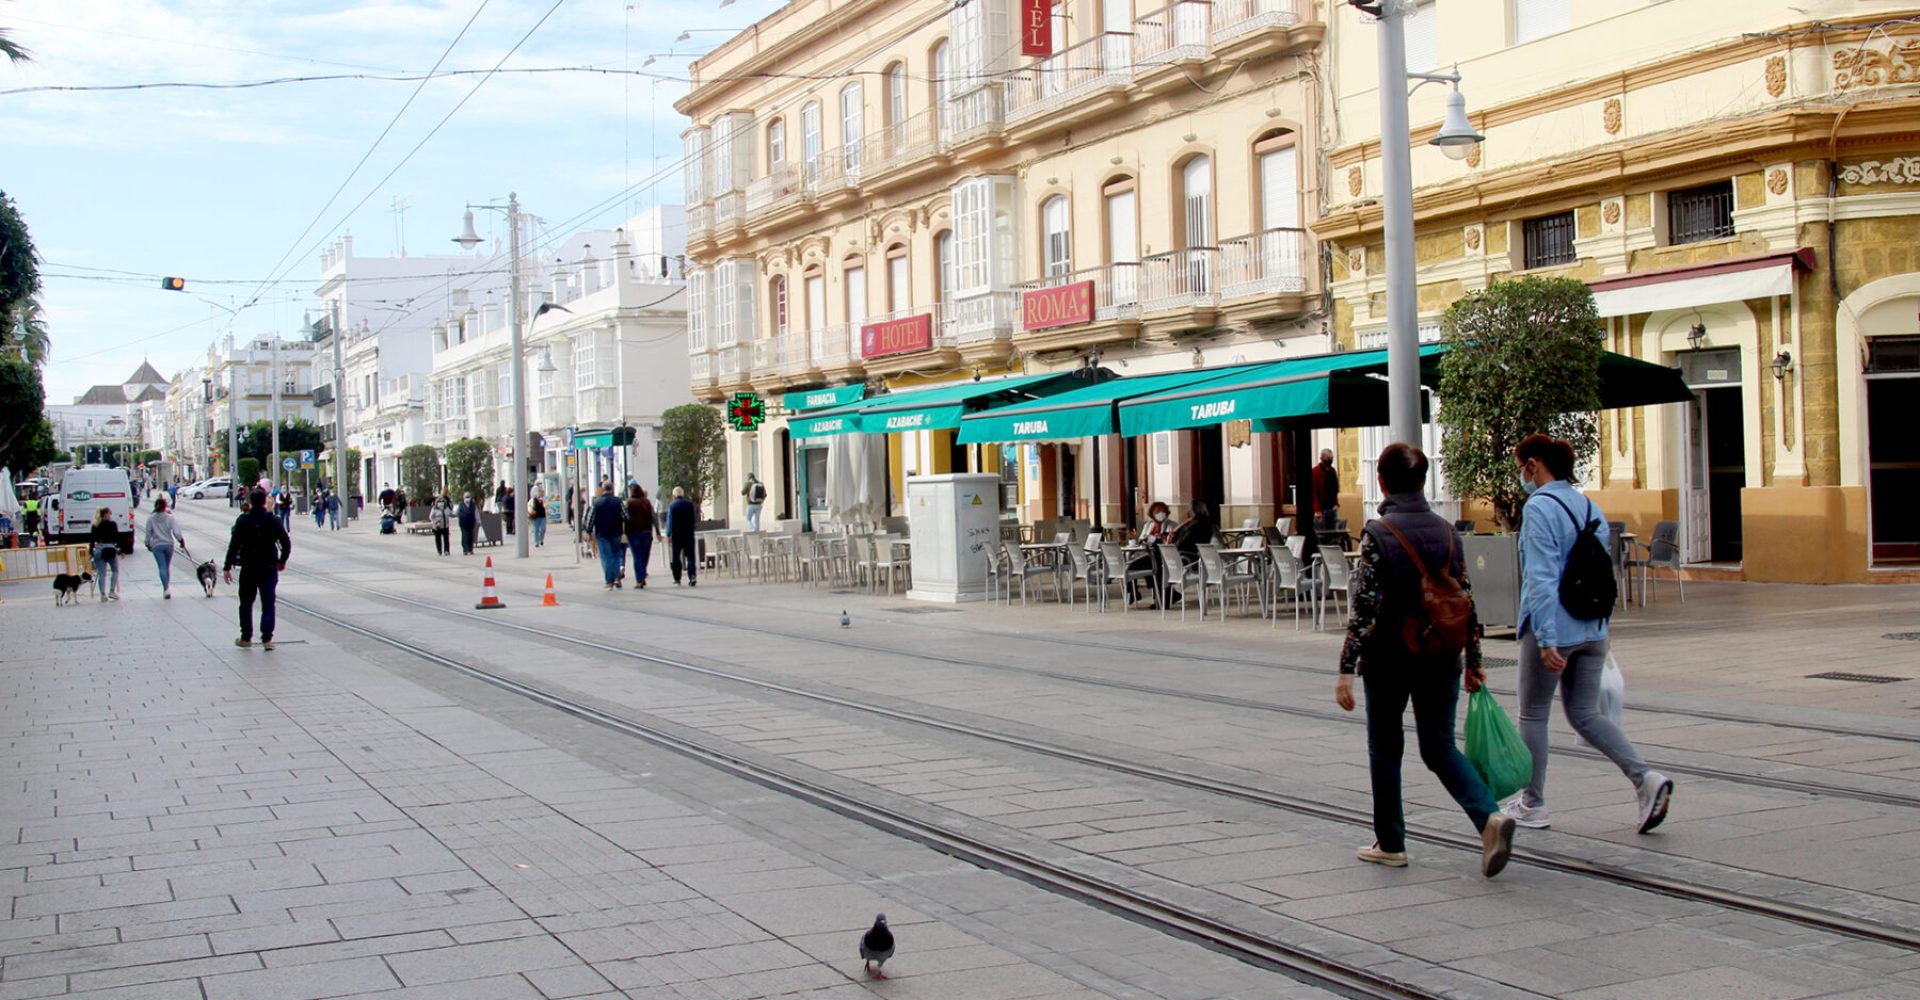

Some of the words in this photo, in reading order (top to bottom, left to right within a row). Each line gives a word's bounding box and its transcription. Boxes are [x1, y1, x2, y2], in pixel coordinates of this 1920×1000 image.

[881, 321, 922, 350] HOTEL
[806, 392, 836, 407] FARMACIA
[1191, 399, 1236, 420] TARUBA
[886, 414, 924, 429] AZABACHE
[1013, 420, 1048, 435] TARUBA
